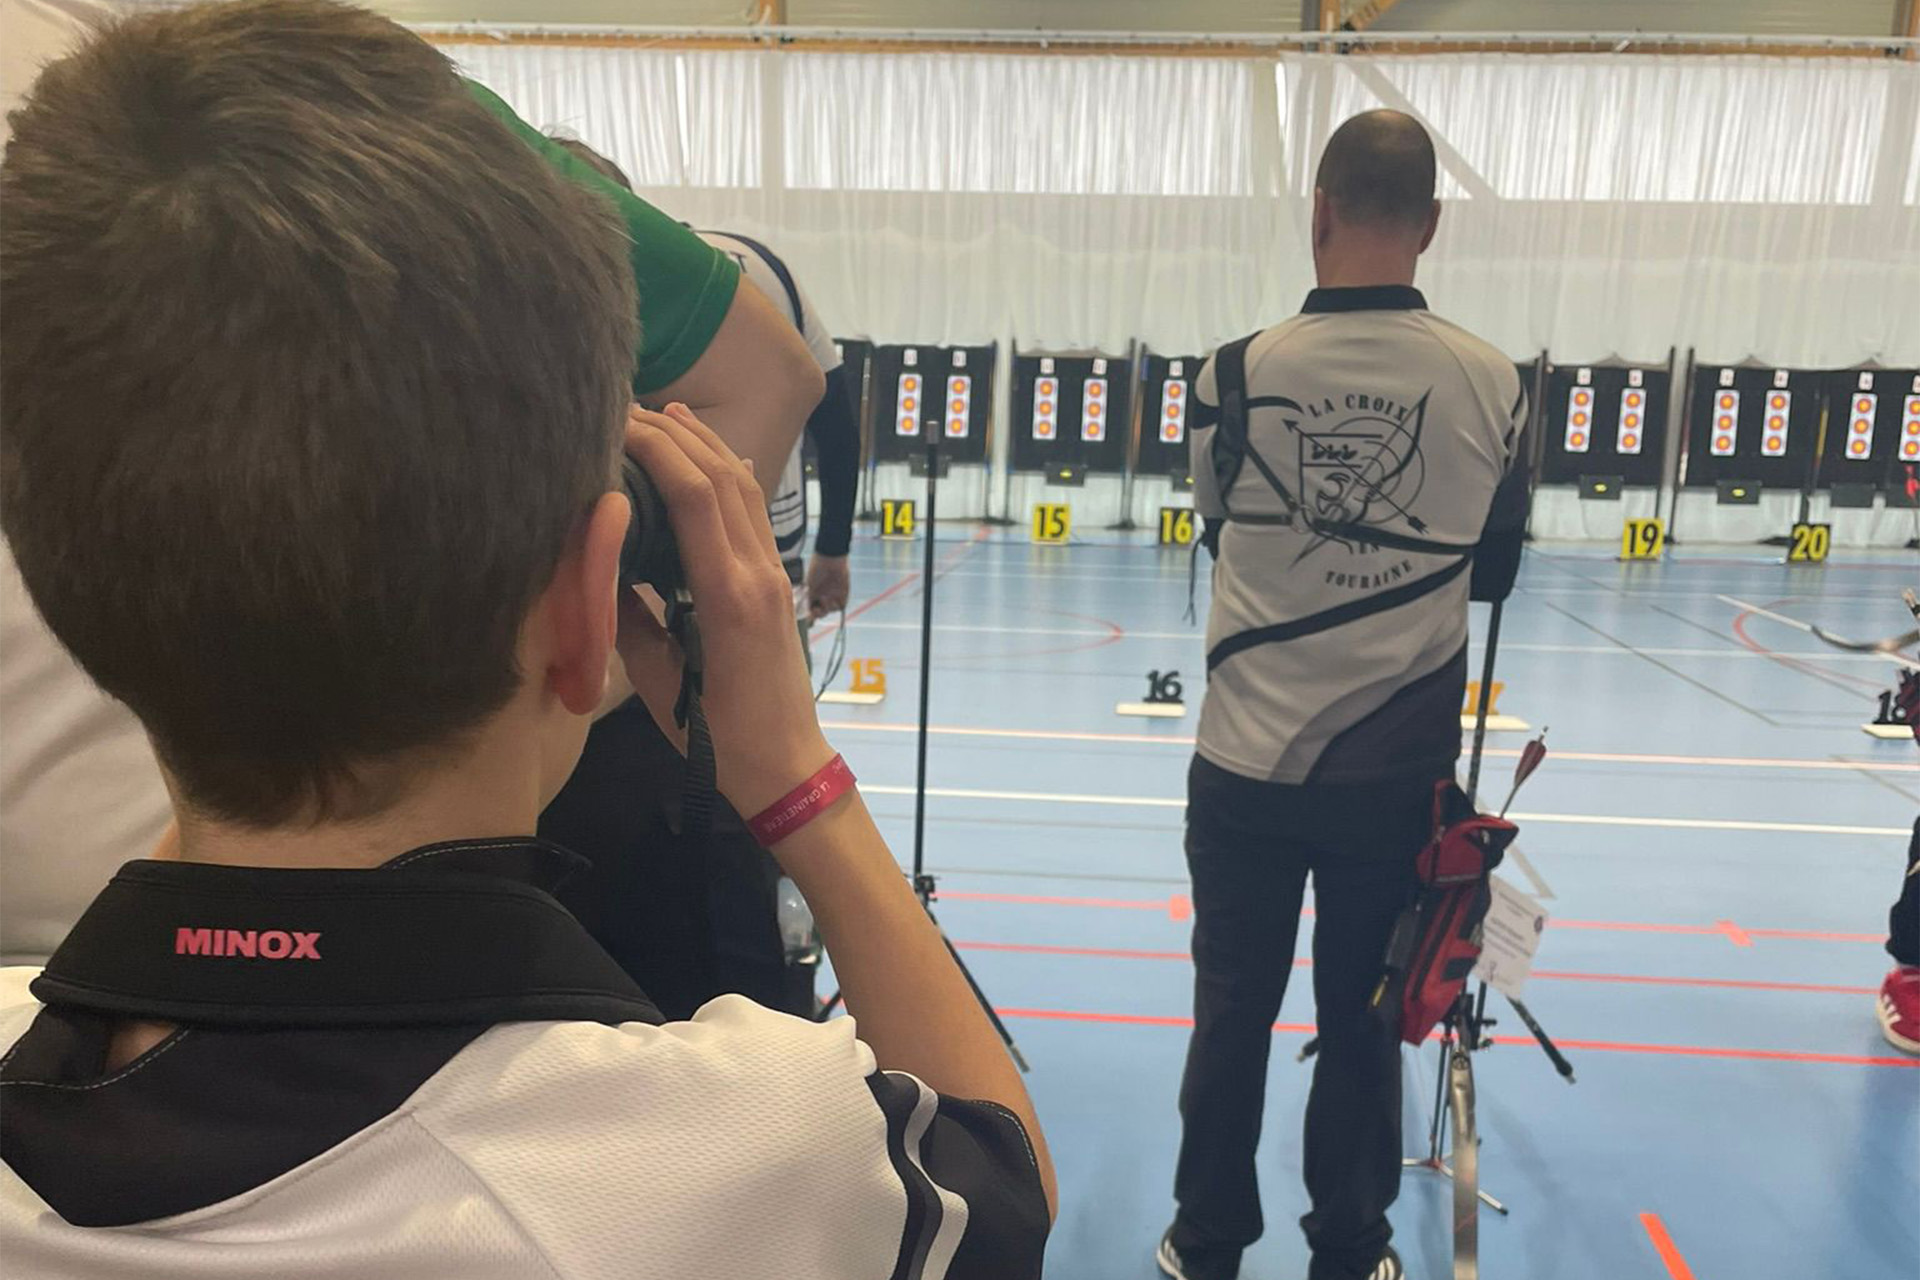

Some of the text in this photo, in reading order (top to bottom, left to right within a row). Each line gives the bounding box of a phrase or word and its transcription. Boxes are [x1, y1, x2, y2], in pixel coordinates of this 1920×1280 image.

[1308, 393, 1408, 421] LA CROIX
[883, 501, 914, 535] 14
[1039, 506, 1064, 538] 15
[1161, 510, 1192, 544] 16
[1629, 522, 1659, 555] 19
[1789, 524, 1829, 561] 20
[1326, 559, 1412, 589] TOURAINE
[850, 658, 887, 694] 15
[1144, 670, 1183, 703] 16
[174, 927, 322, 960] MINOX
